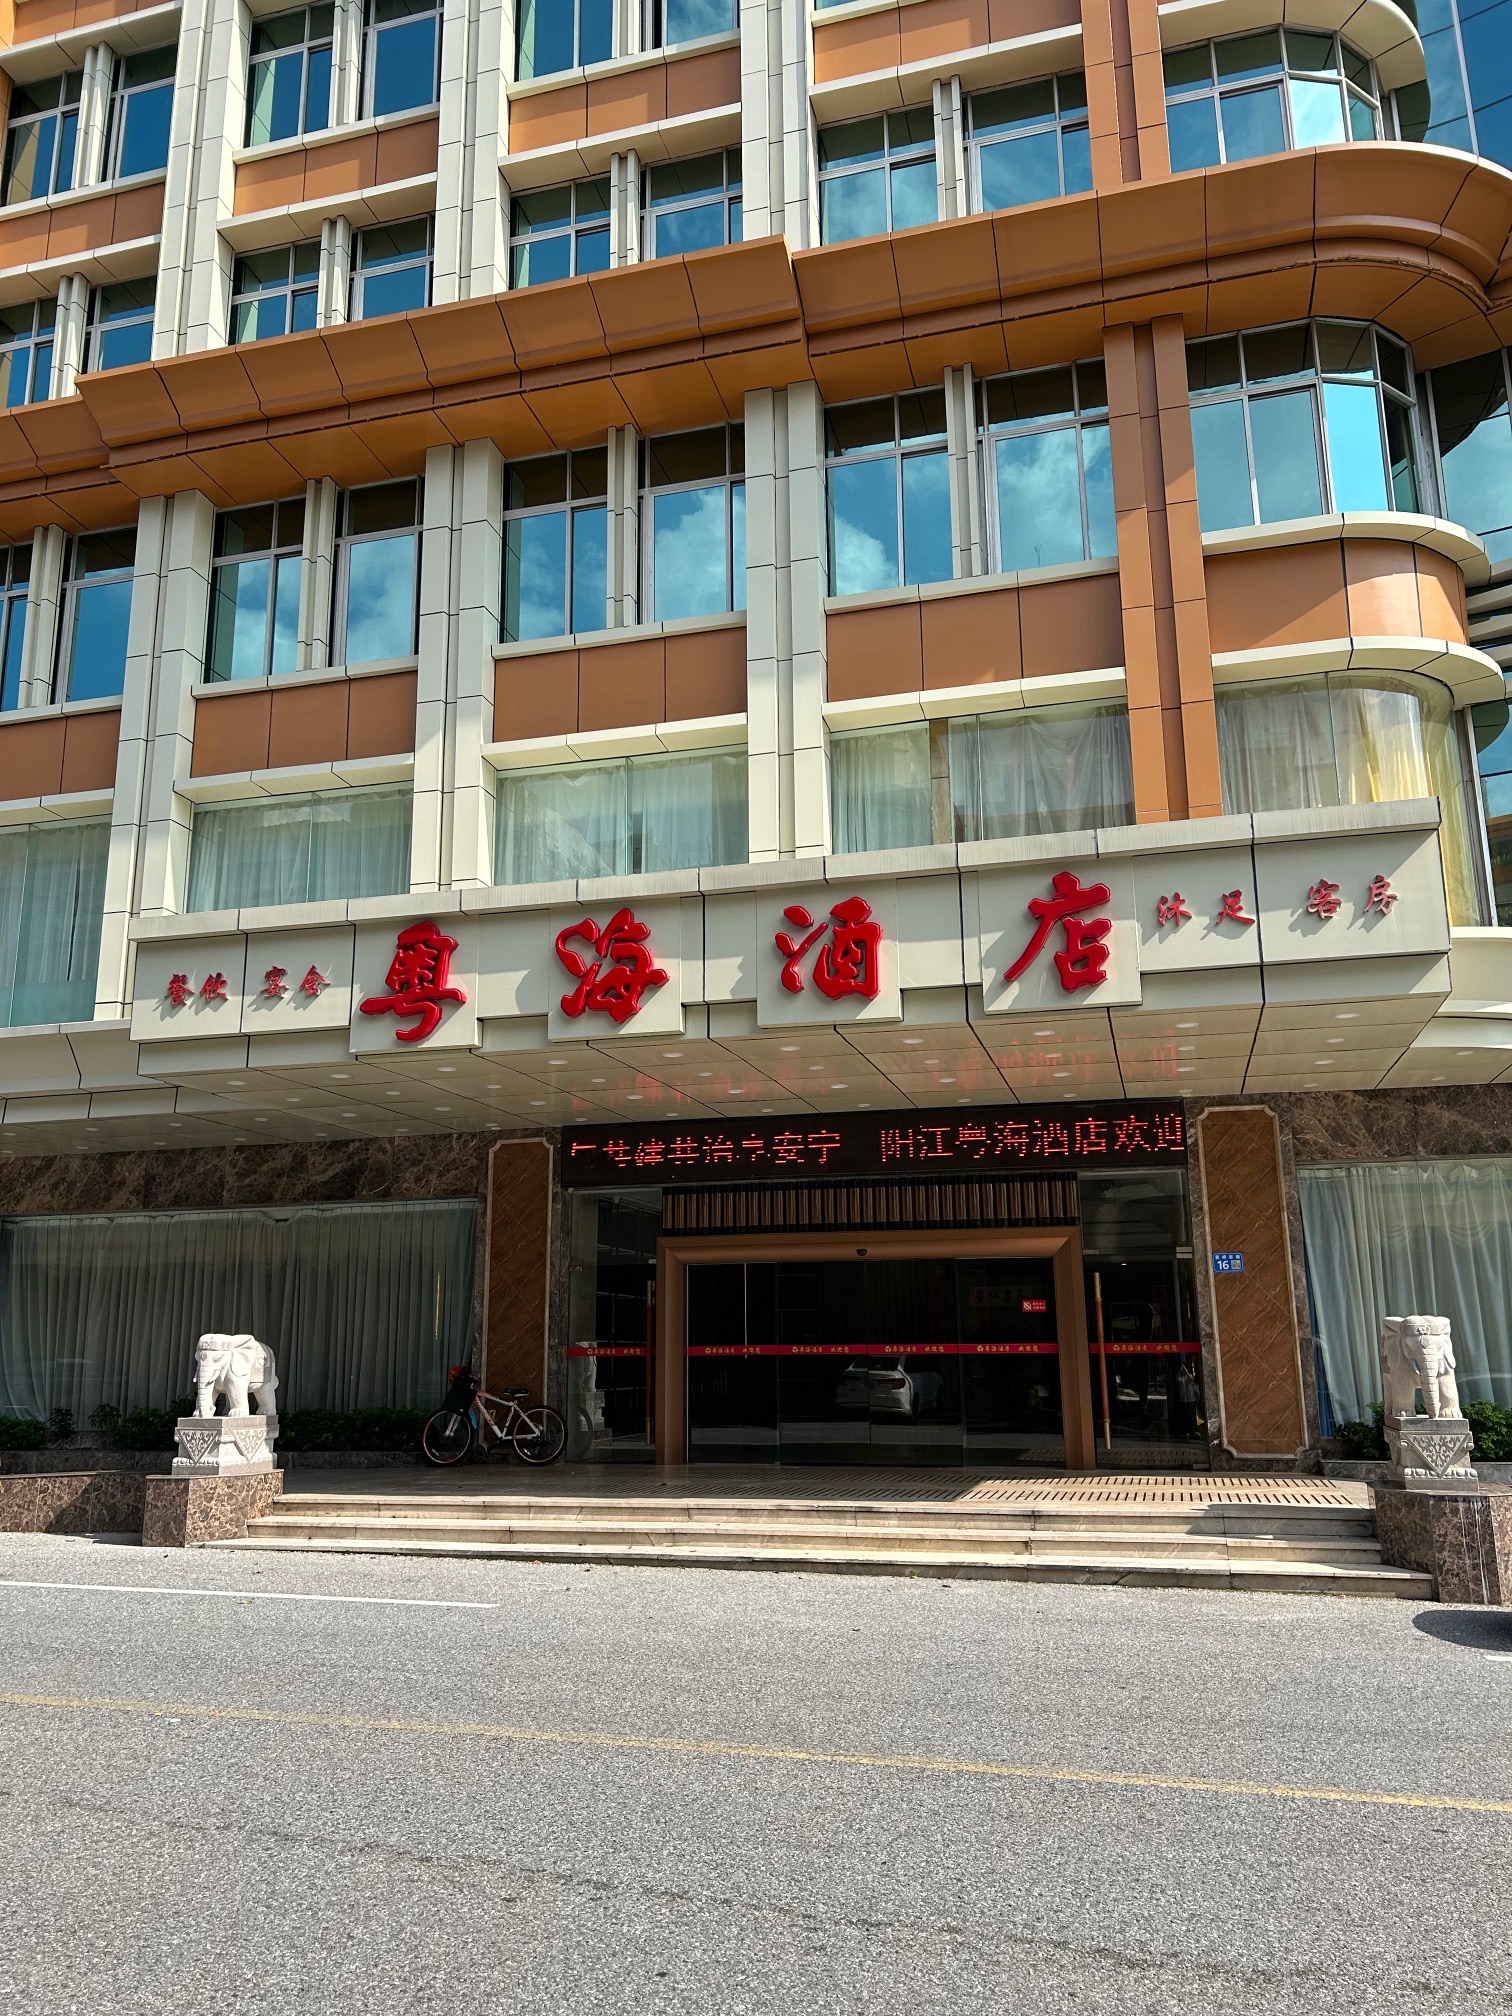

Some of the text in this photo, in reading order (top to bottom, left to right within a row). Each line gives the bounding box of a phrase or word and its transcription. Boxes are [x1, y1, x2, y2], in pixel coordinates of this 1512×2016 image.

[1158, 875, 1397, 926] 沐足 客房
[360, 872, 1112, 1042] 粤海酒店
[168, 965, 330, 1007] 餐饮 宴会
[1217, 1260, 1230, 1270] 16
